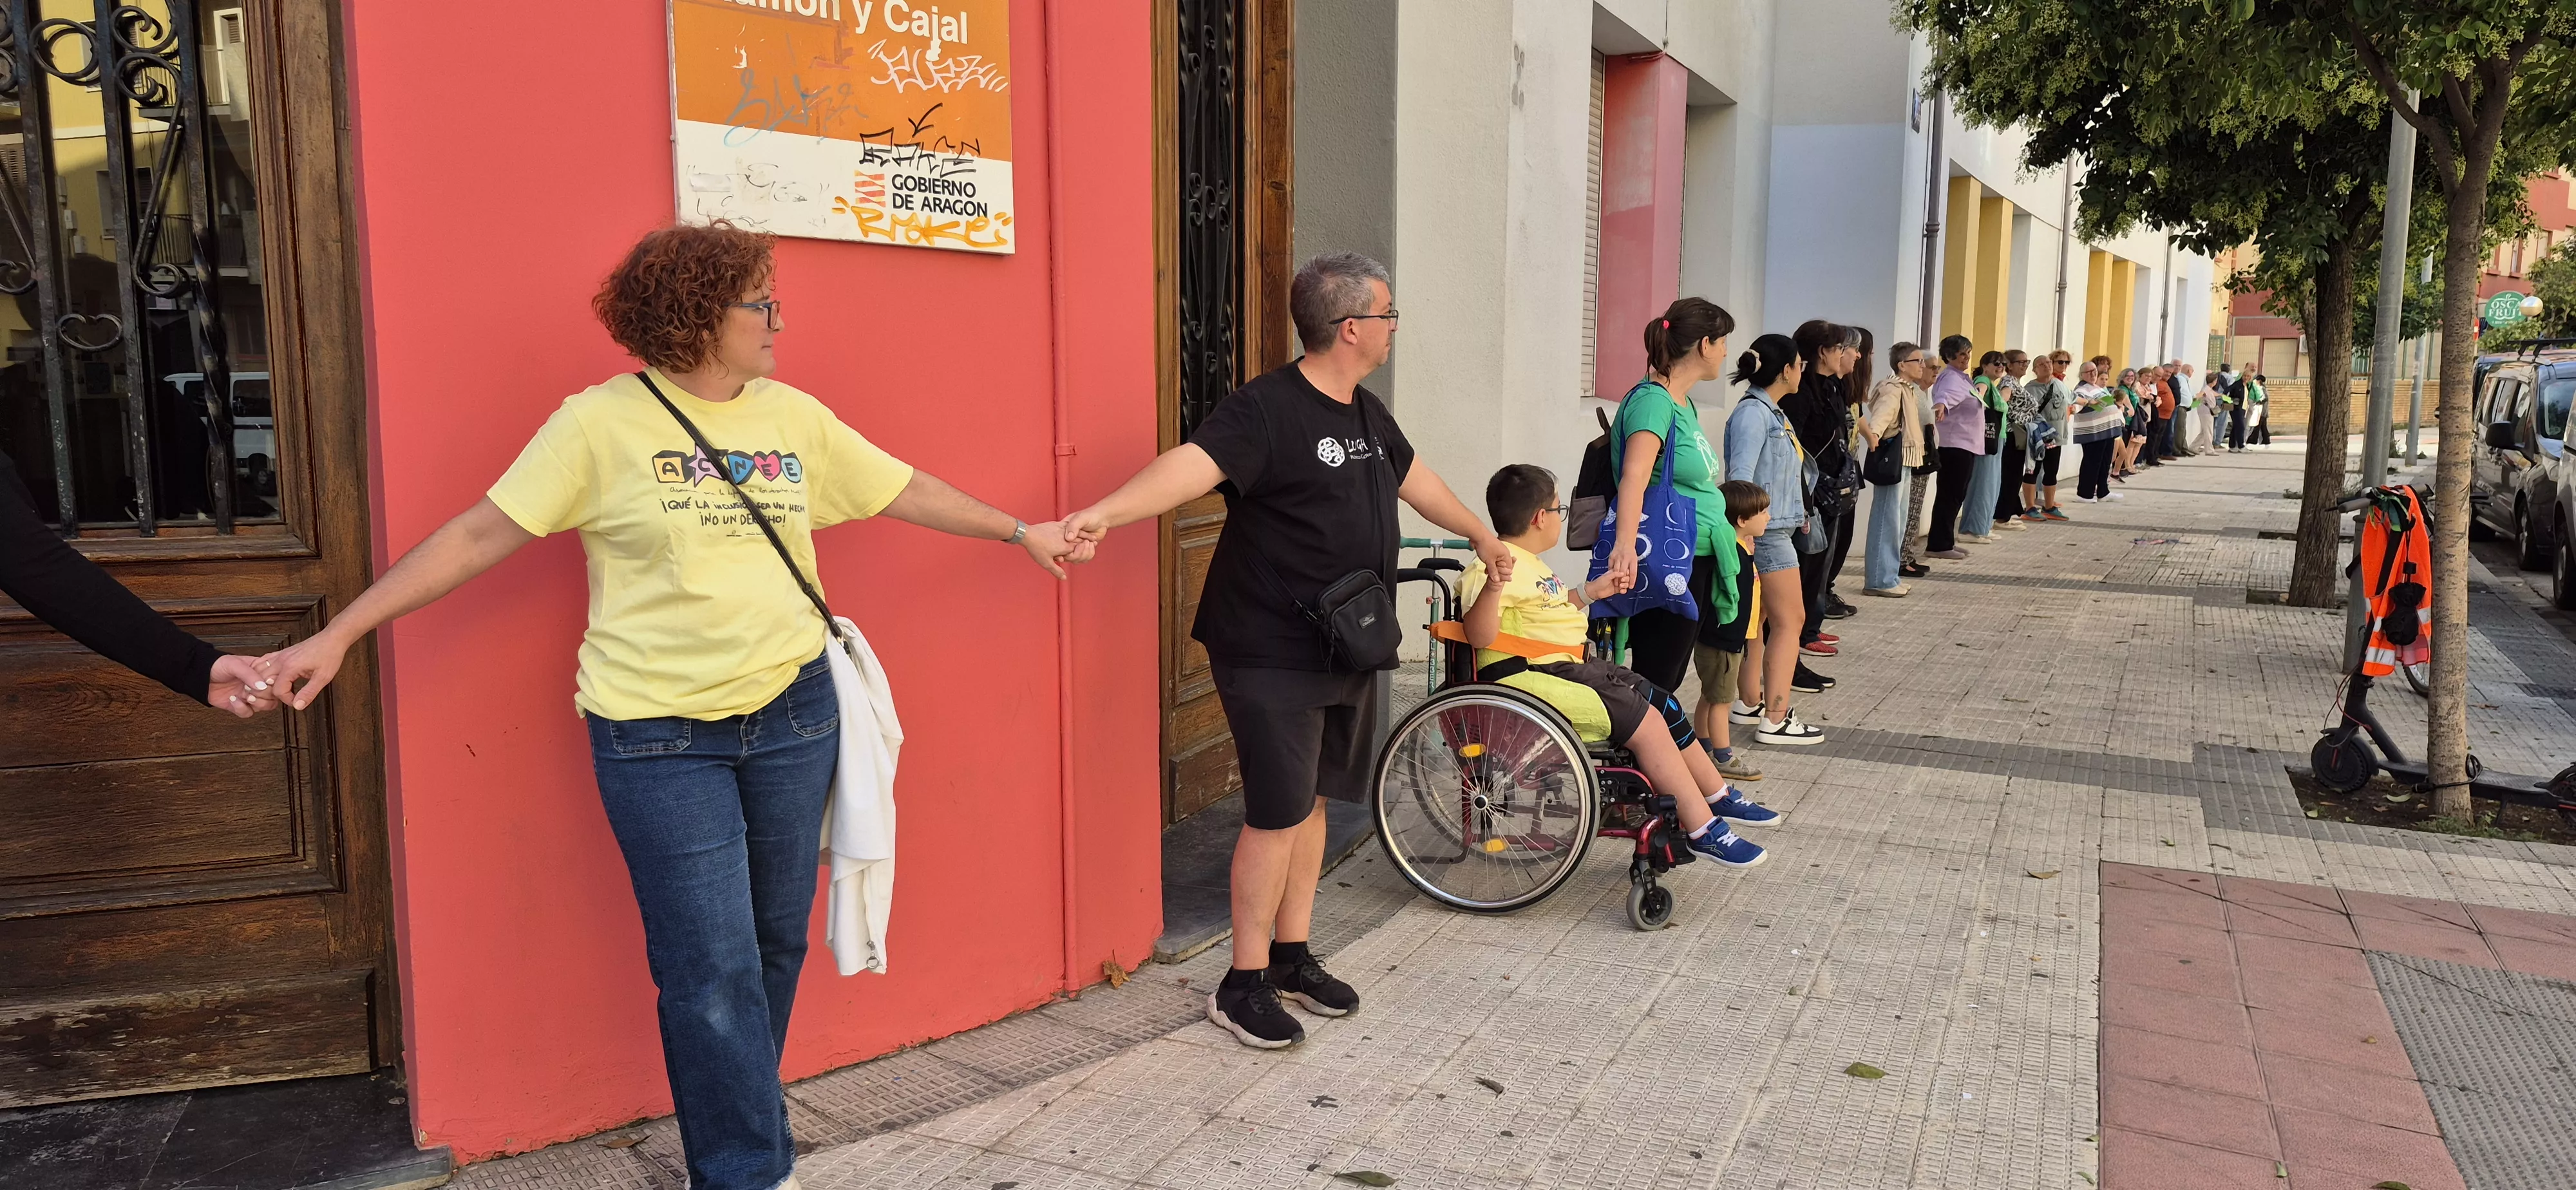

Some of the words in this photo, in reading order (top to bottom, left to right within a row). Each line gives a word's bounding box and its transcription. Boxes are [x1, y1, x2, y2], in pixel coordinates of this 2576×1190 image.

[852, 0, 873, 34] y
[884, 0, 968, 52] Cajal
[891, 173, 976, 198] GOBIERNO
[893, 193, 914, 211] DE
[920, 196, 989, 218] ARAGON
[1345, 438, 1368, 453] LUGH
[695, 500, 710, 509] LA
[773, 501, 785, 510] UN
[723, 514, 737, 525] UN
